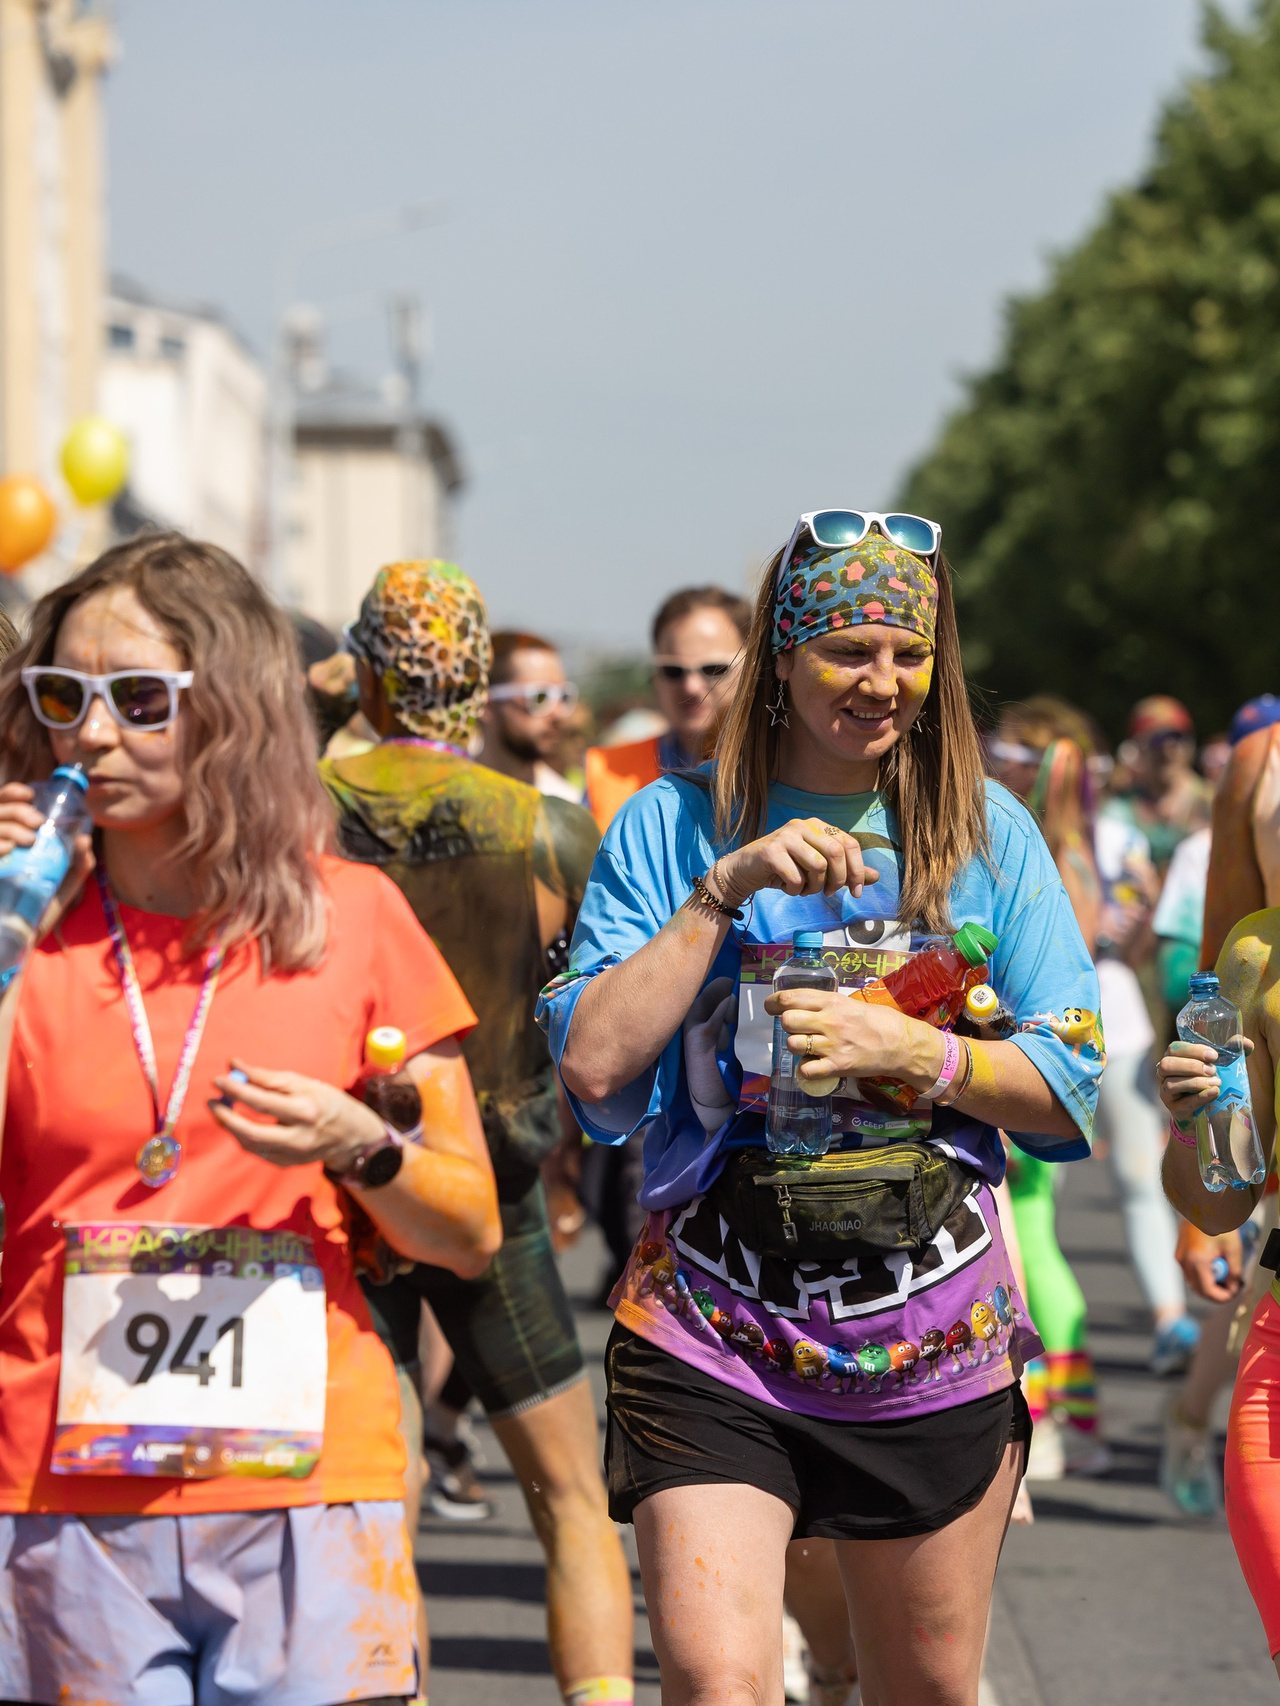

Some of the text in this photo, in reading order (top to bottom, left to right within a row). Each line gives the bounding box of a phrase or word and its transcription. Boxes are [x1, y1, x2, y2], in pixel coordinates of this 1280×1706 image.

[863, 1120, 884, 1130] СБЕР
[809, 1219, 862, 1232] JHAONIAO
[125, 1313, 244, 1388] 941
